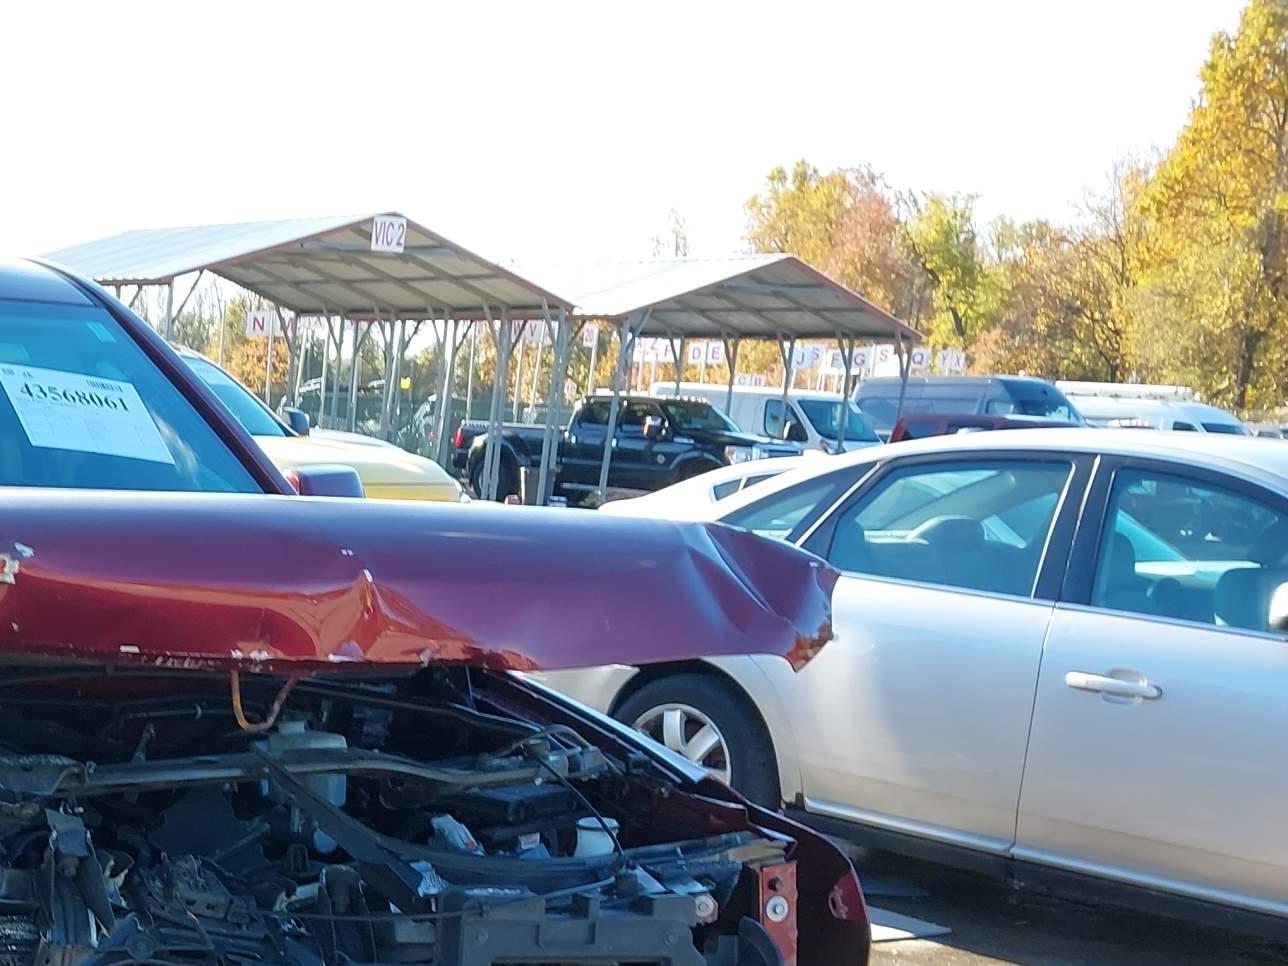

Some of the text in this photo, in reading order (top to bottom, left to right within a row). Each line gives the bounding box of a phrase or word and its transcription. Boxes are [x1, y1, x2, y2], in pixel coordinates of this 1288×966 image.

[375, 220, 405, 247] VIC 2
[252, 316, 264, 331] N
[692, 347, 701, 360] D
[712, 346, 720, 360] E
[796, 351, 805, 365] J
[854, 352, 866, 367] G
[880, 348, 889, 361] S
[912, 351, 924, 366] Q
[21, 383, 129, 412] 43568061
